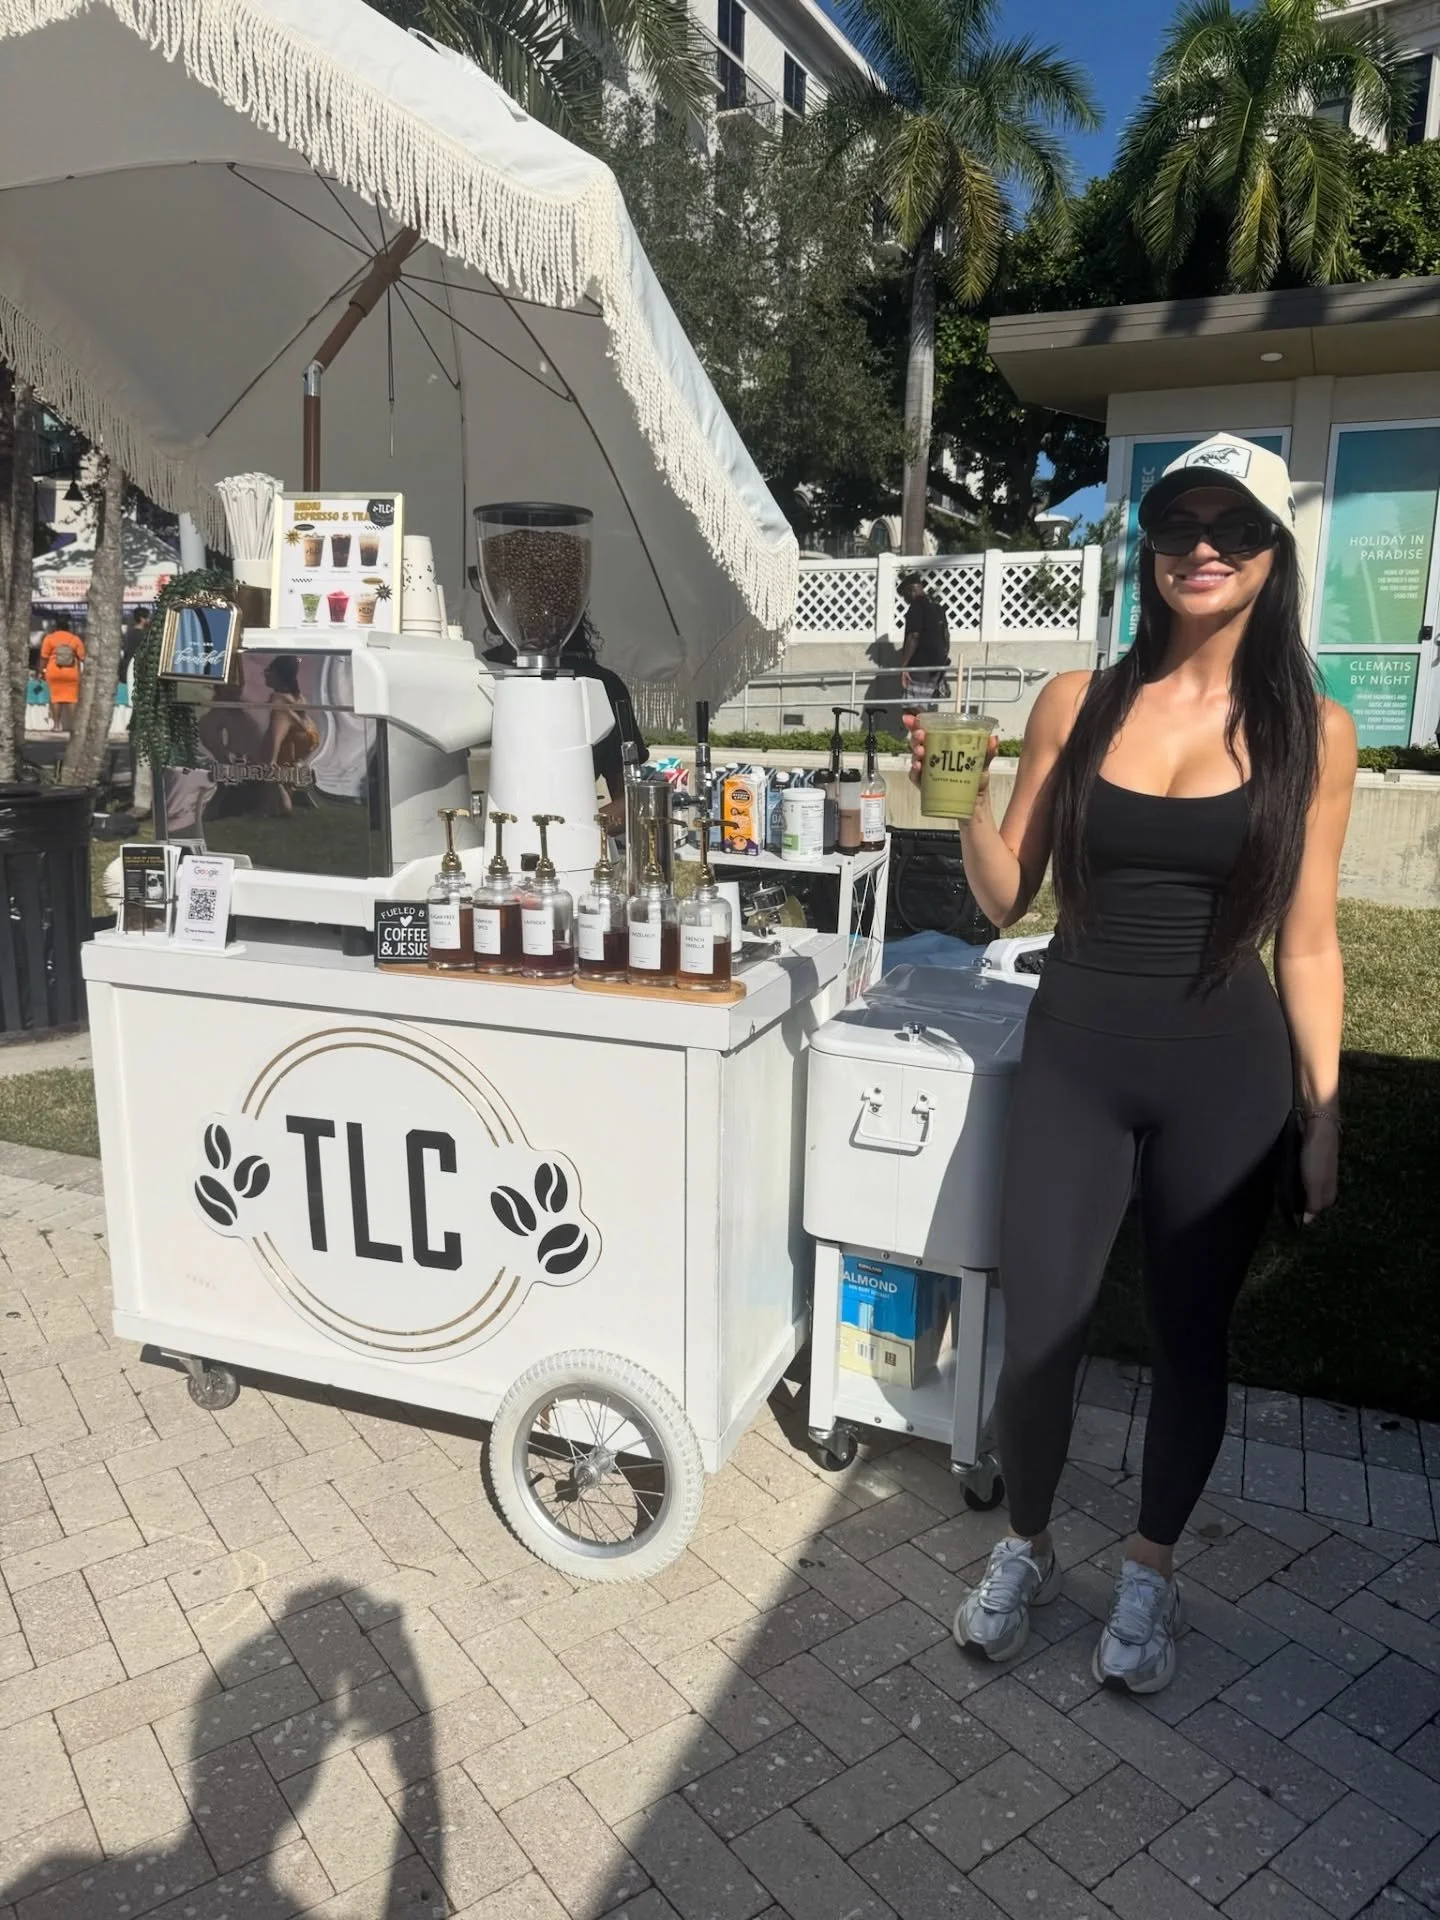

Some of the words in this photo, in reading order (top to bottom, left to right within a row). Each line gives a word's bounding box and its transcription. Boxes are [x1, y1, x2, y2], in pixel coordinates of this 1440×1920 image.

[378, 504, 392, 514] TLC
[294, 512, 339, 521] ESPRESSO
[342, 512, 349, 521] &
[1349, 535, 1406, 547] HOLIDAY
[1411, 535, 1424, 545] IN
[1360, 549, 1423, 561] PARADISE
[1350, 661, 1411, 672] CLEMATIS
[1350, 675, 1366, 685] BY
[1370, 675, 1411, 685] NIGHT
[941, 750, 965, 772] TLC
[194, 866, 220, 878] Google
[380, 907, 416, 920] FUELED
[384, 927, 428, 942] COFFEE
[381, 941, 393, 956] &
[394, 942, 429, 957] JESUS
[285, 1114, 463, 1271] TLC
[843, 1271, 898, 1294] ALMOND
